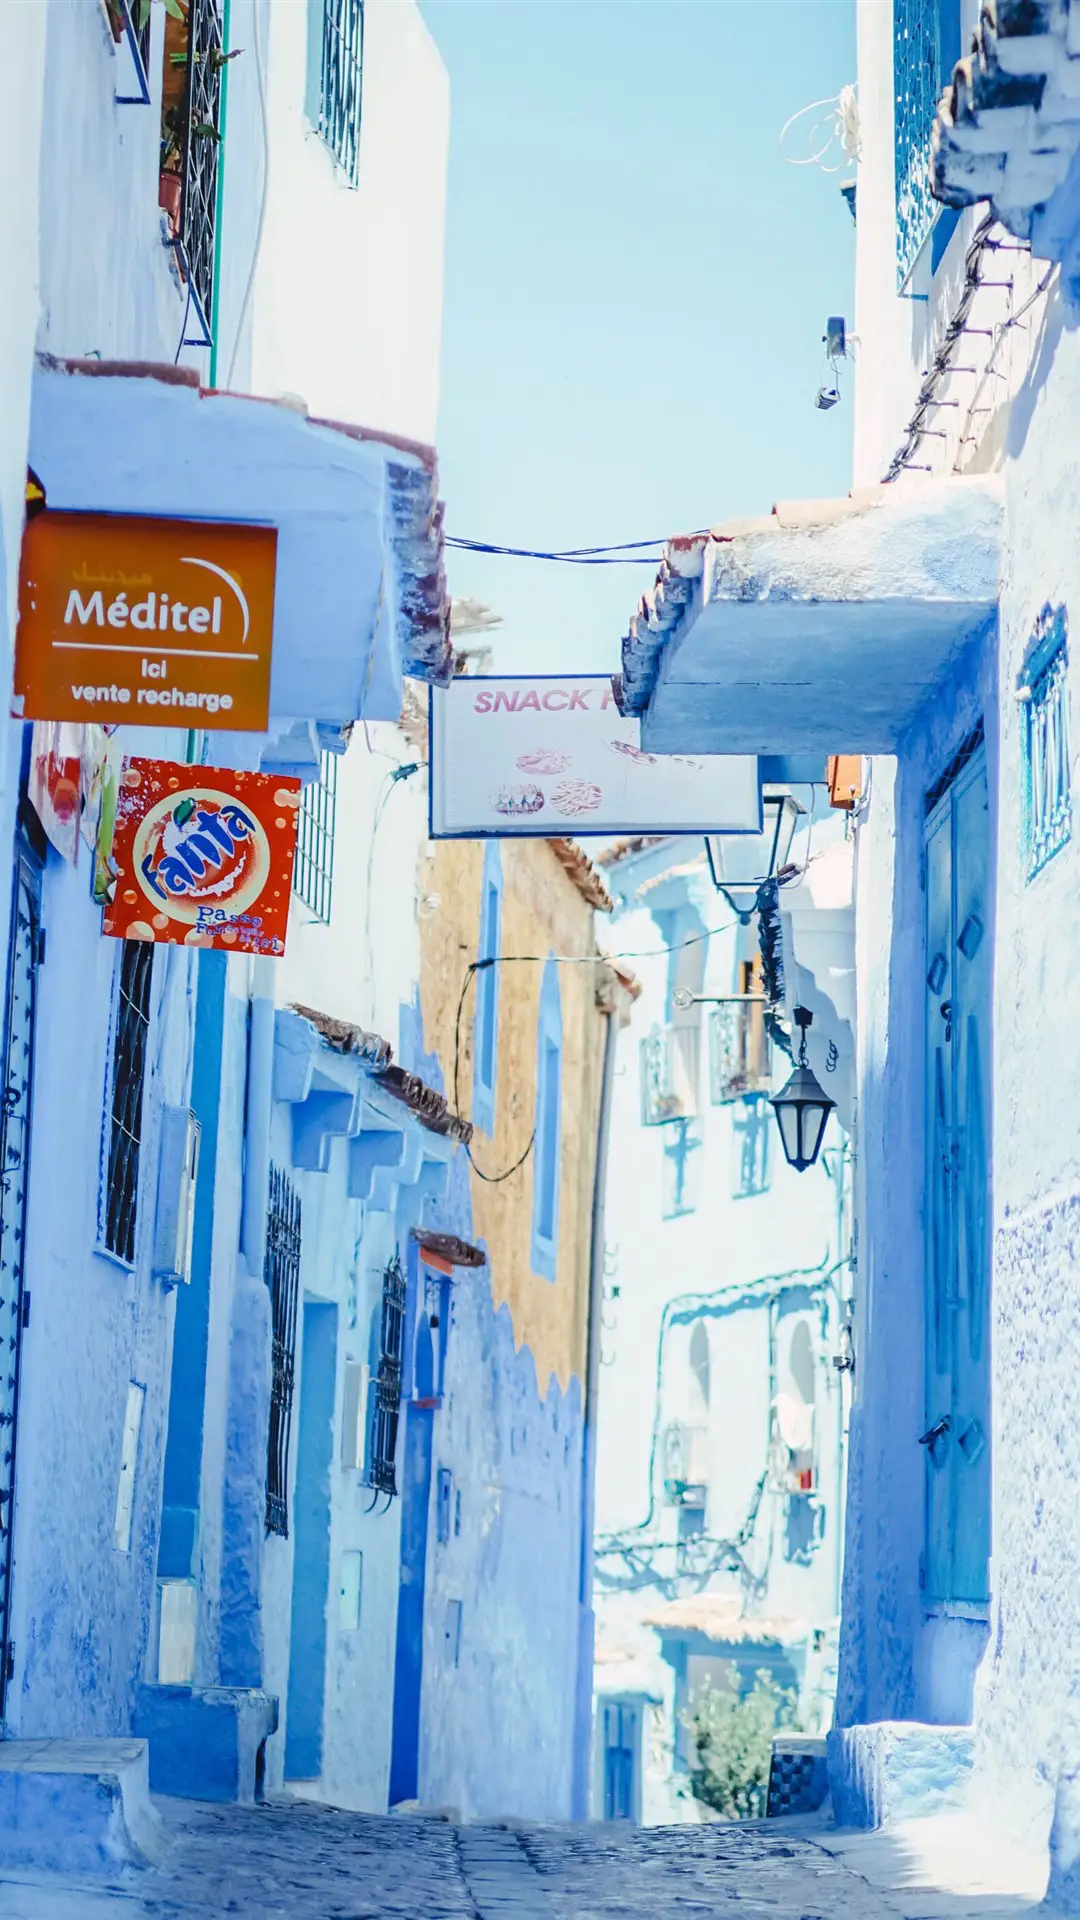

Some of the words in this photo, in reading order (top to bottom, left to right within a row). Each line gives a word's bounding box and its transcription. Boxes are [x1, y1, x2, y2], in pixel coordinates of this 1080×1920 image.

[64, 589, 222, 635] Méditel
[141, 658, 167, 679] Ici
[71, 684, 131, 704] vente
[136, 686, 234, 713] recharge
[473, 689, 594, 714] SNACK
[196, 906, 262, 927] Passe
